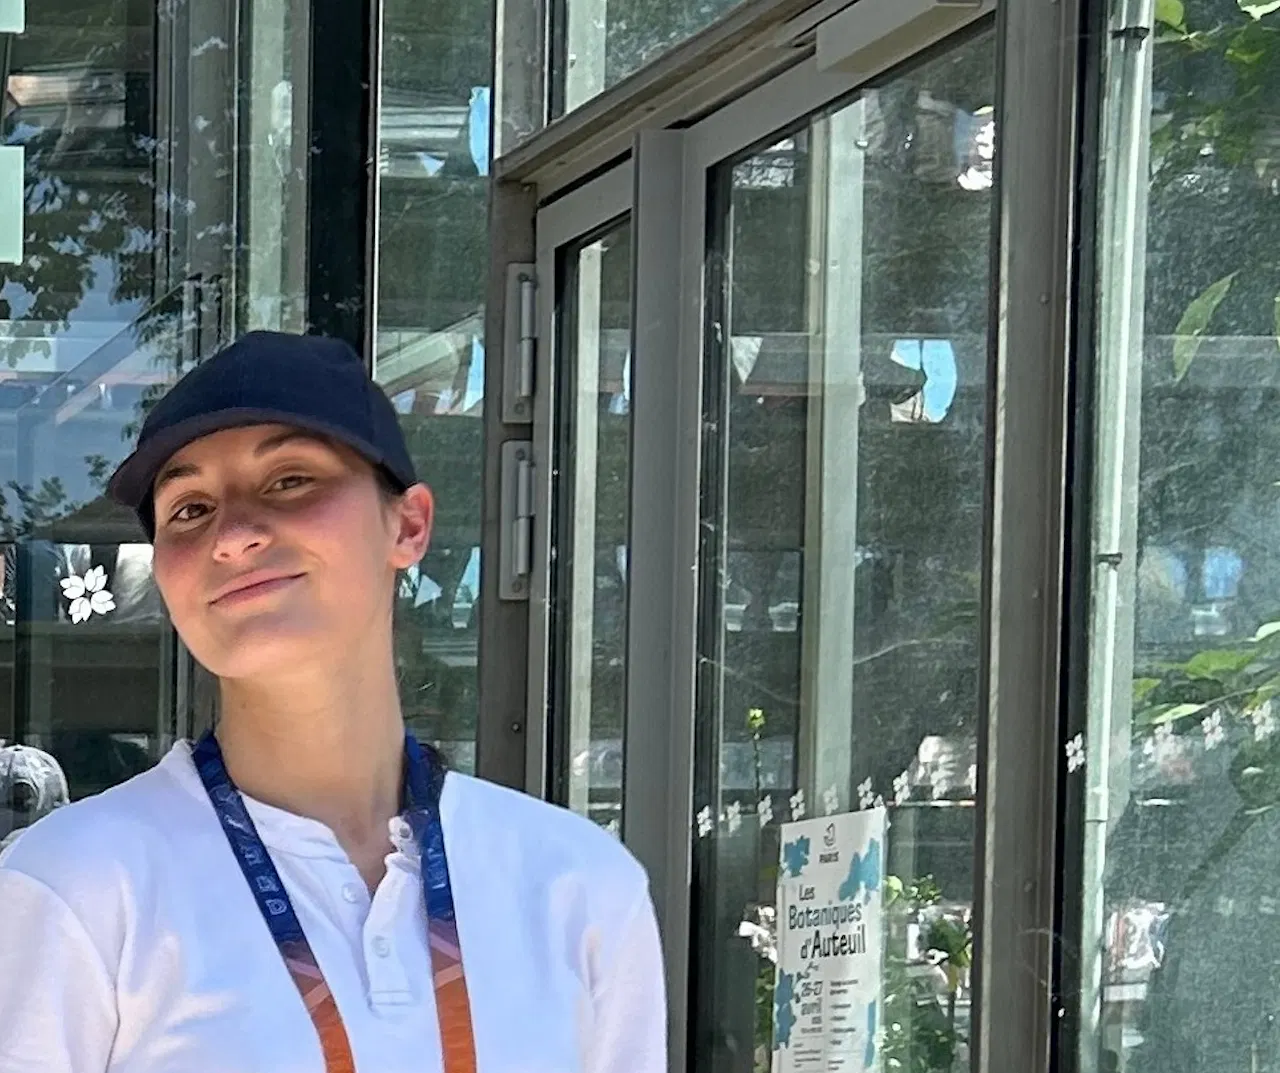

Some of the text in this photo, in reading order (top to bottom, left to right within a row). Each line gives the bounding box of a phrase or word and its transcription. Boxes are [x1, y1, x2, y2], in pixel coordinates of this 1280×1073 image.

[799, 884, 815, 902] Les
[789, 899, 862, 930] Botaniques
[800, 923, 866, 959] d'Auteuil
